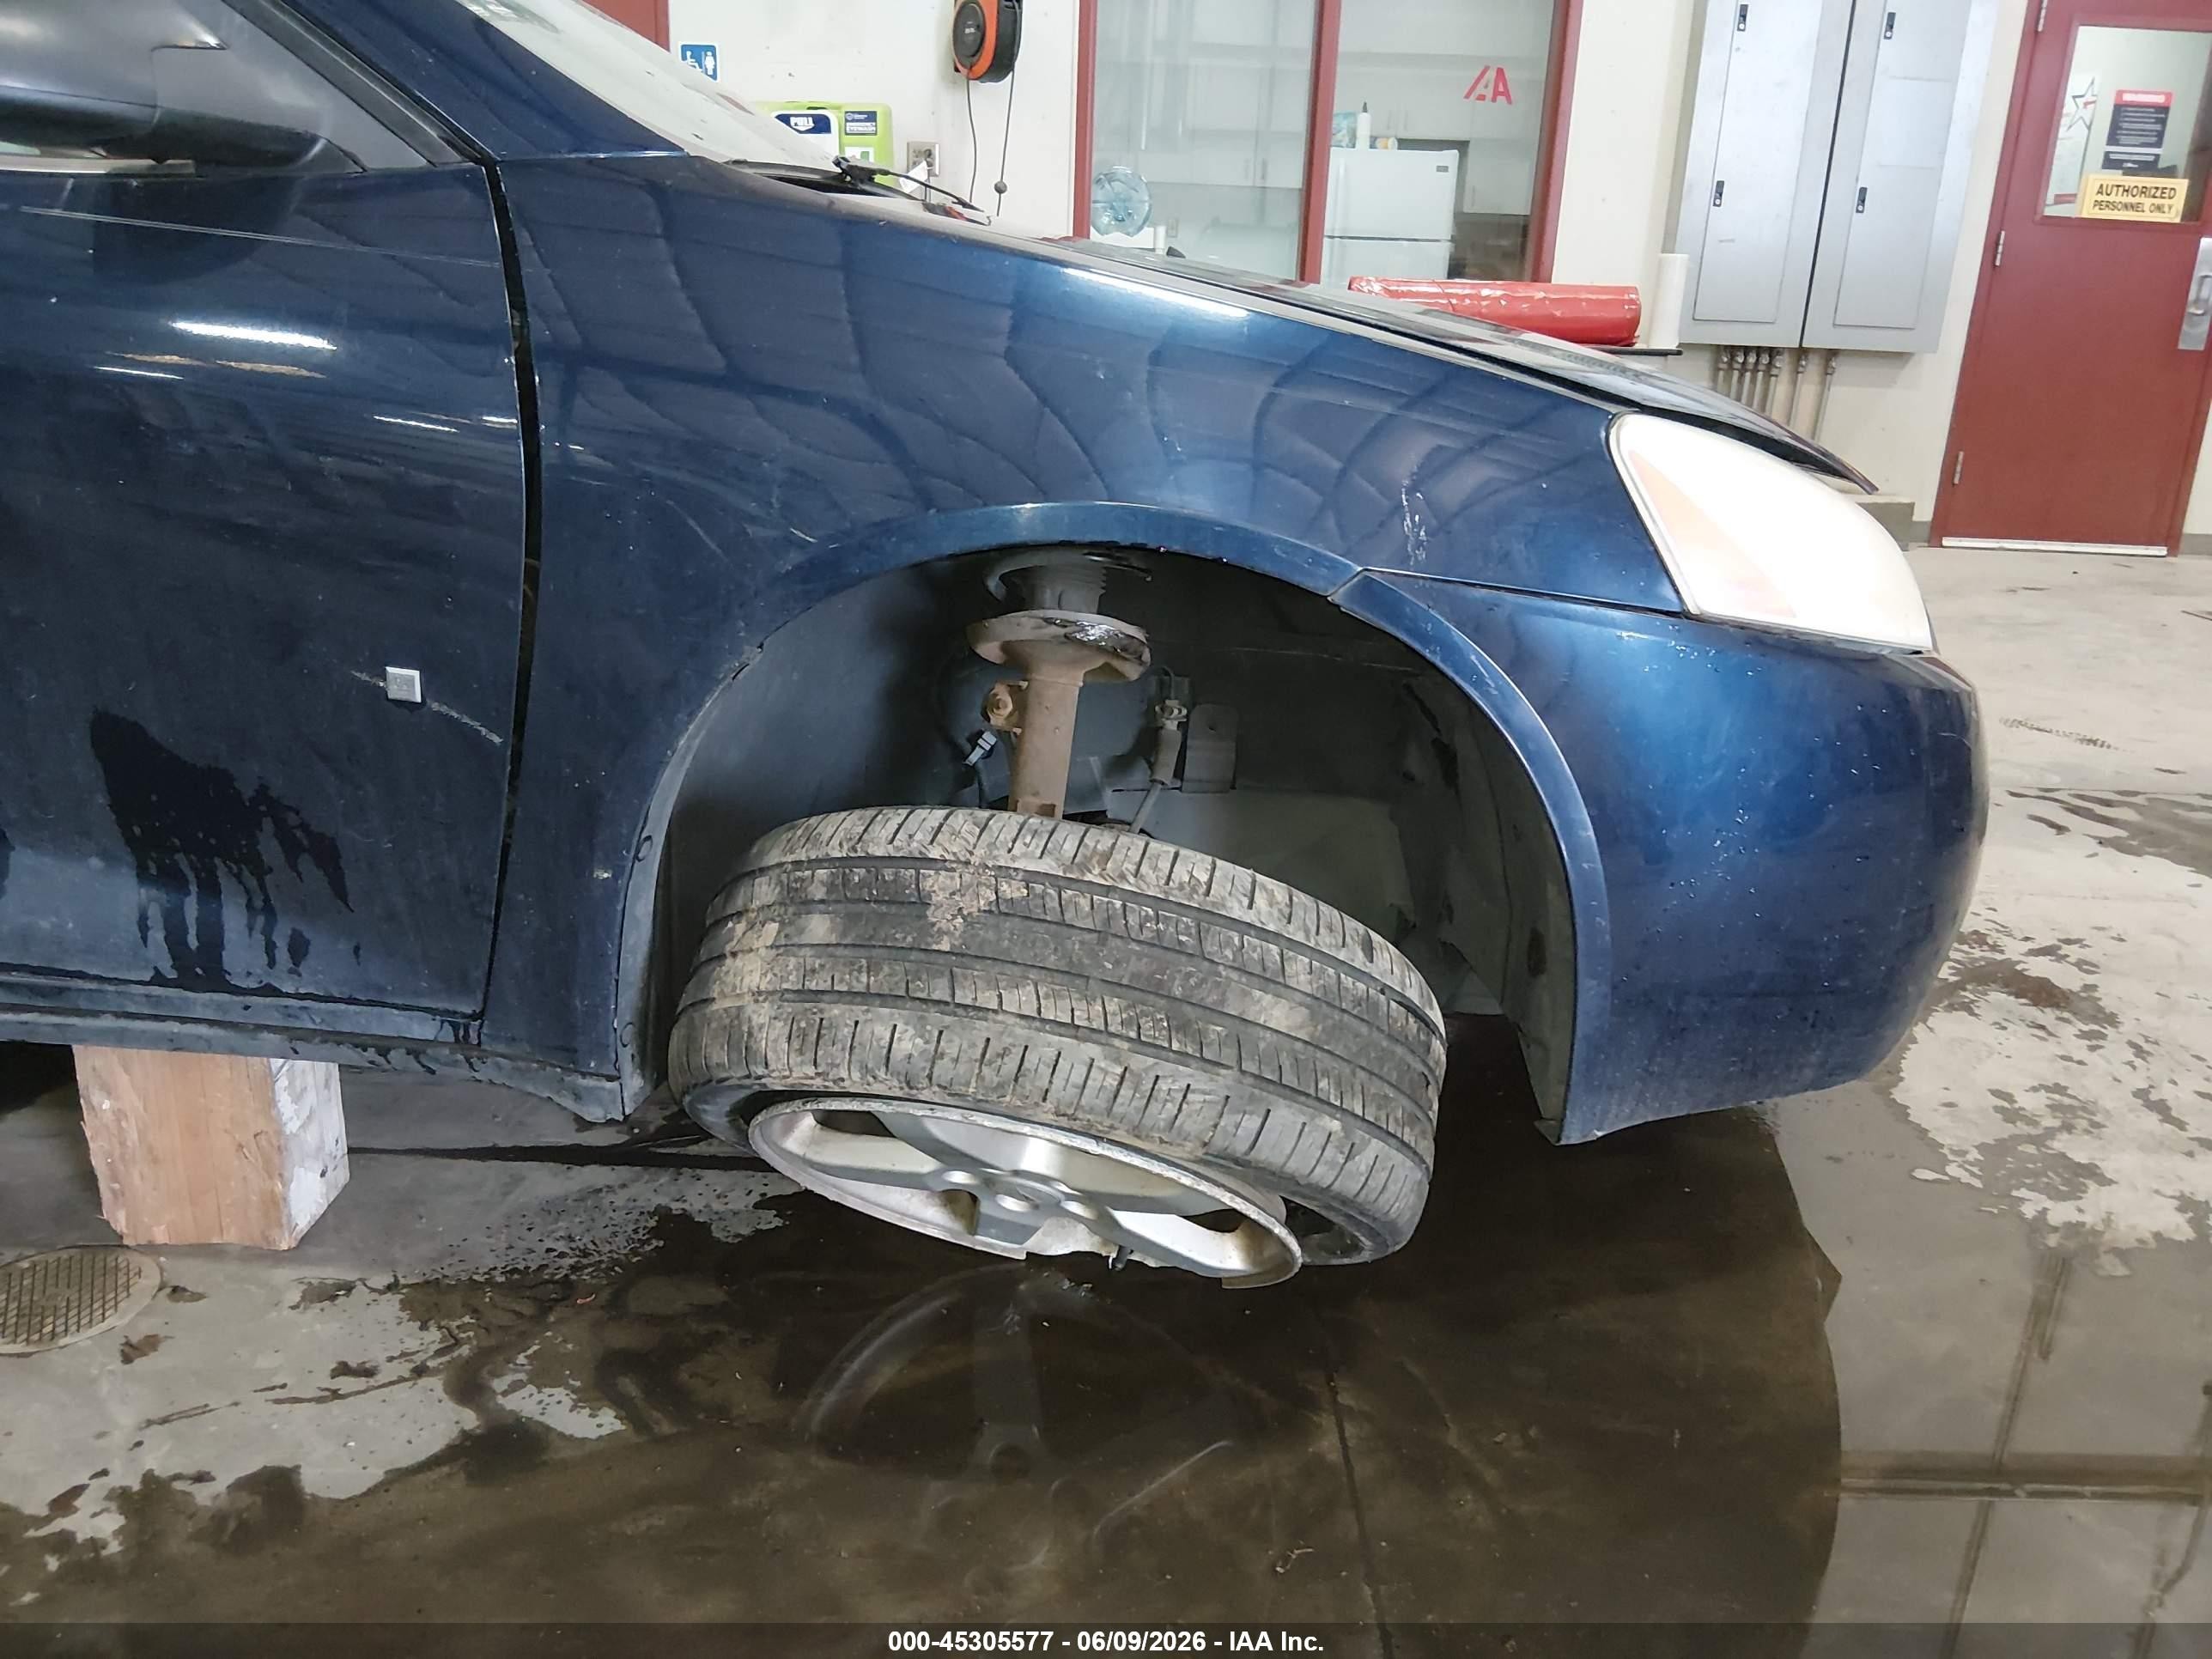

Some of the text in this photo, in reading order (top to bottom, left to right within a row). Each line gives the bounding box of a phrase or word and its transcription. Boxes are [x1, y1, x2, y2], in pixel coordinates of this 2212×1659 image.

[790, 116, 815, 126] PULL
[2096, 183, 2177, 200] AUTHORIZED
[2093, 199, 2174, 214] PERSONNEL ONLY
